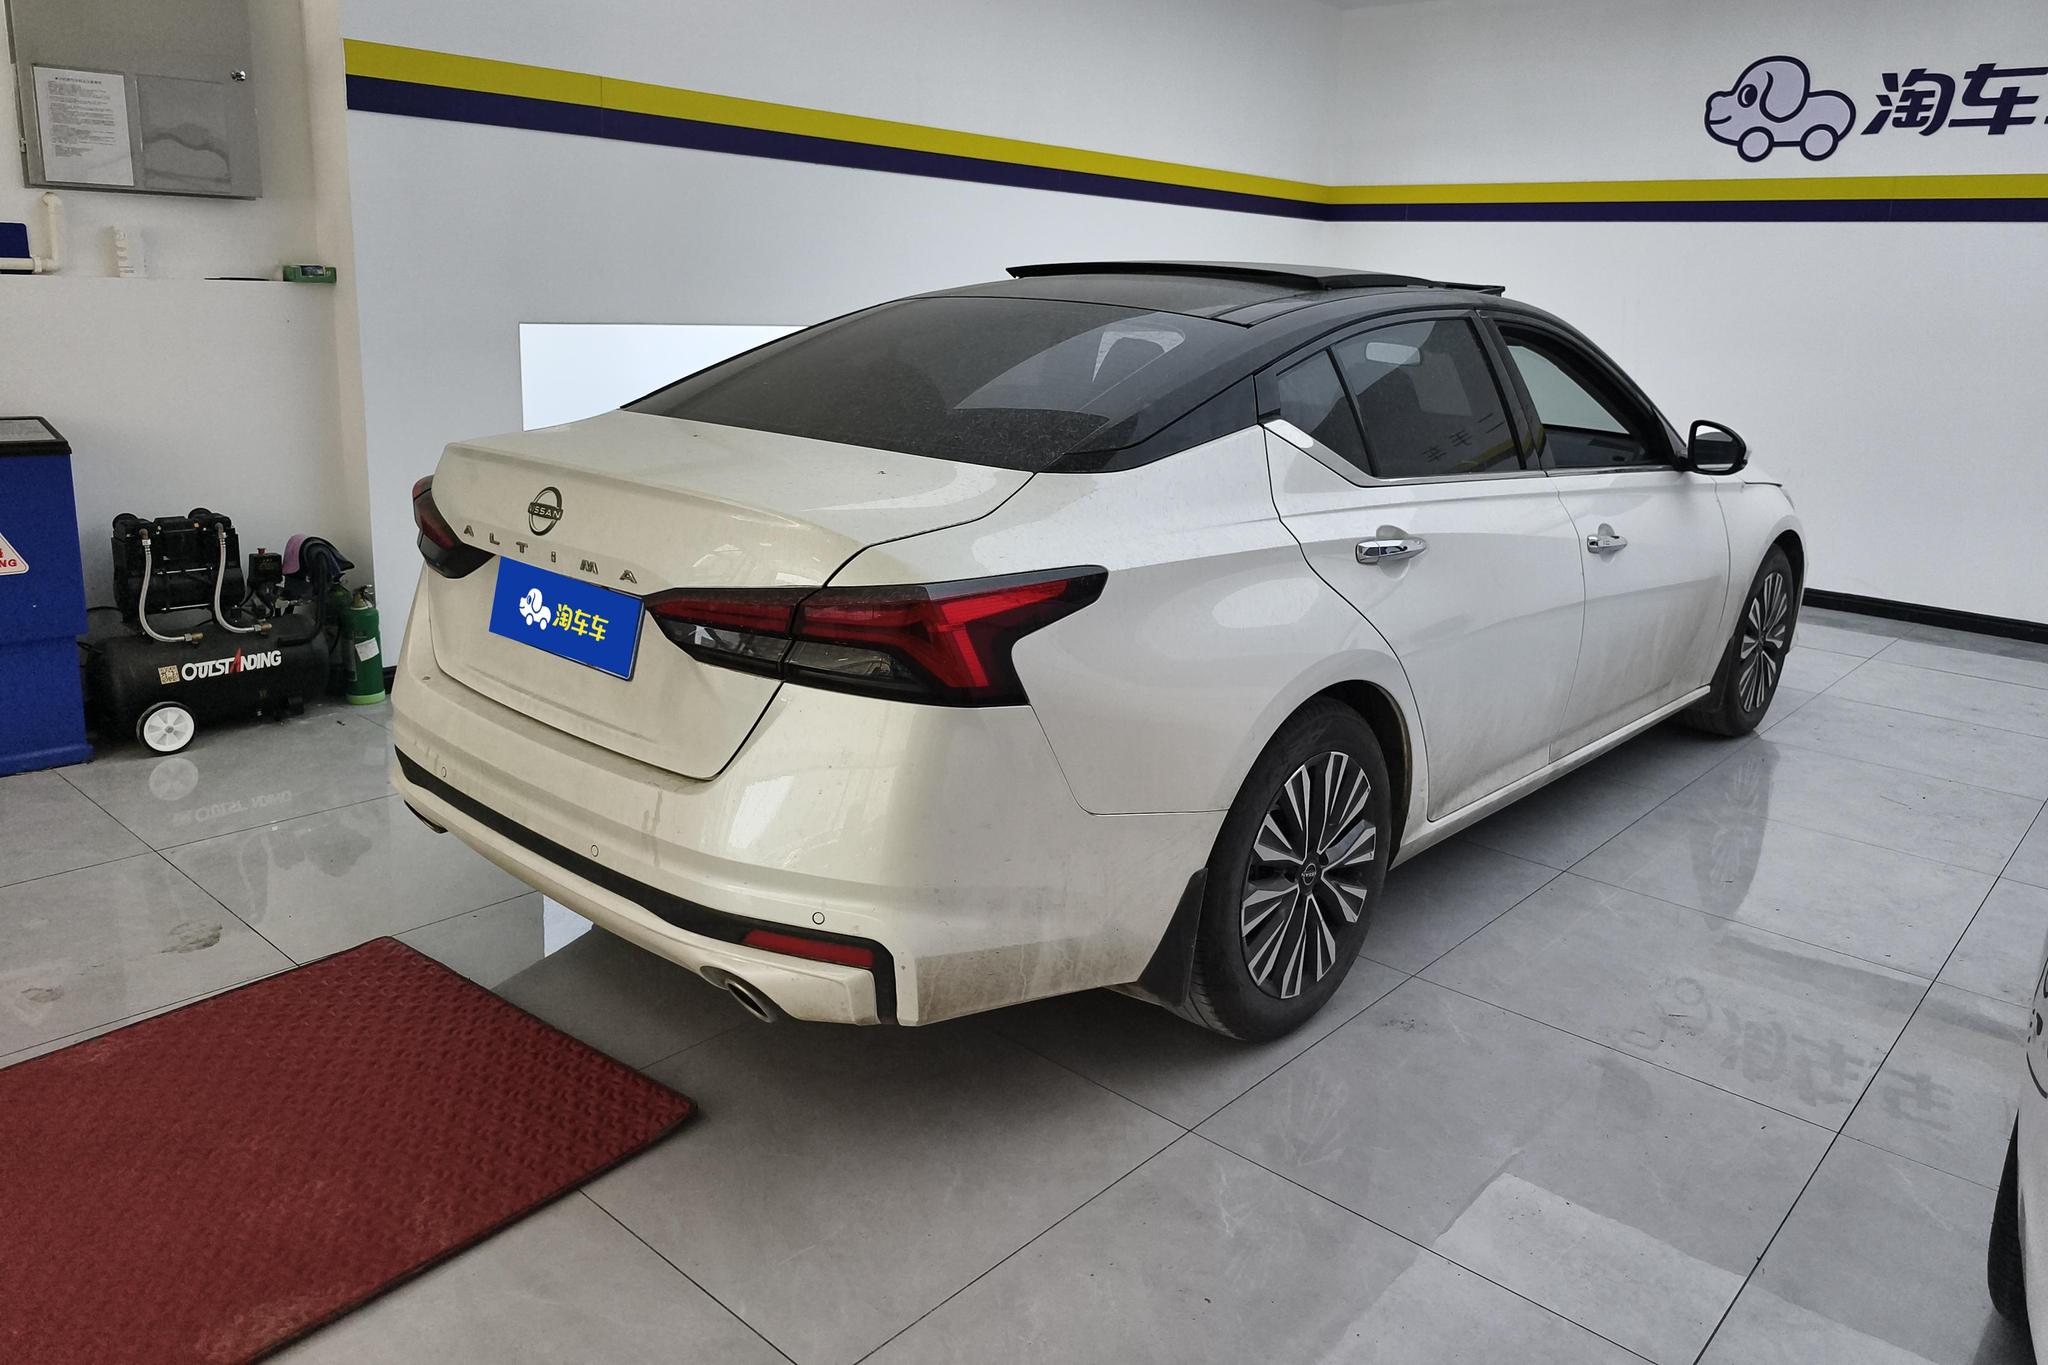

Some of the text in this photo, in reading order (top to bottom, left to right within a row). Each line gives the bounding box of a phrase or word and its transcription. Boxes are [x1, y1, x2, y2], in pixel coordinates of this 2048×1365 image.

[1860, 62, 2048, 137] 淘车
[464, 525, 638, 584] ALTIMA
[181, 648, 282, 681] OUTSTANDING
